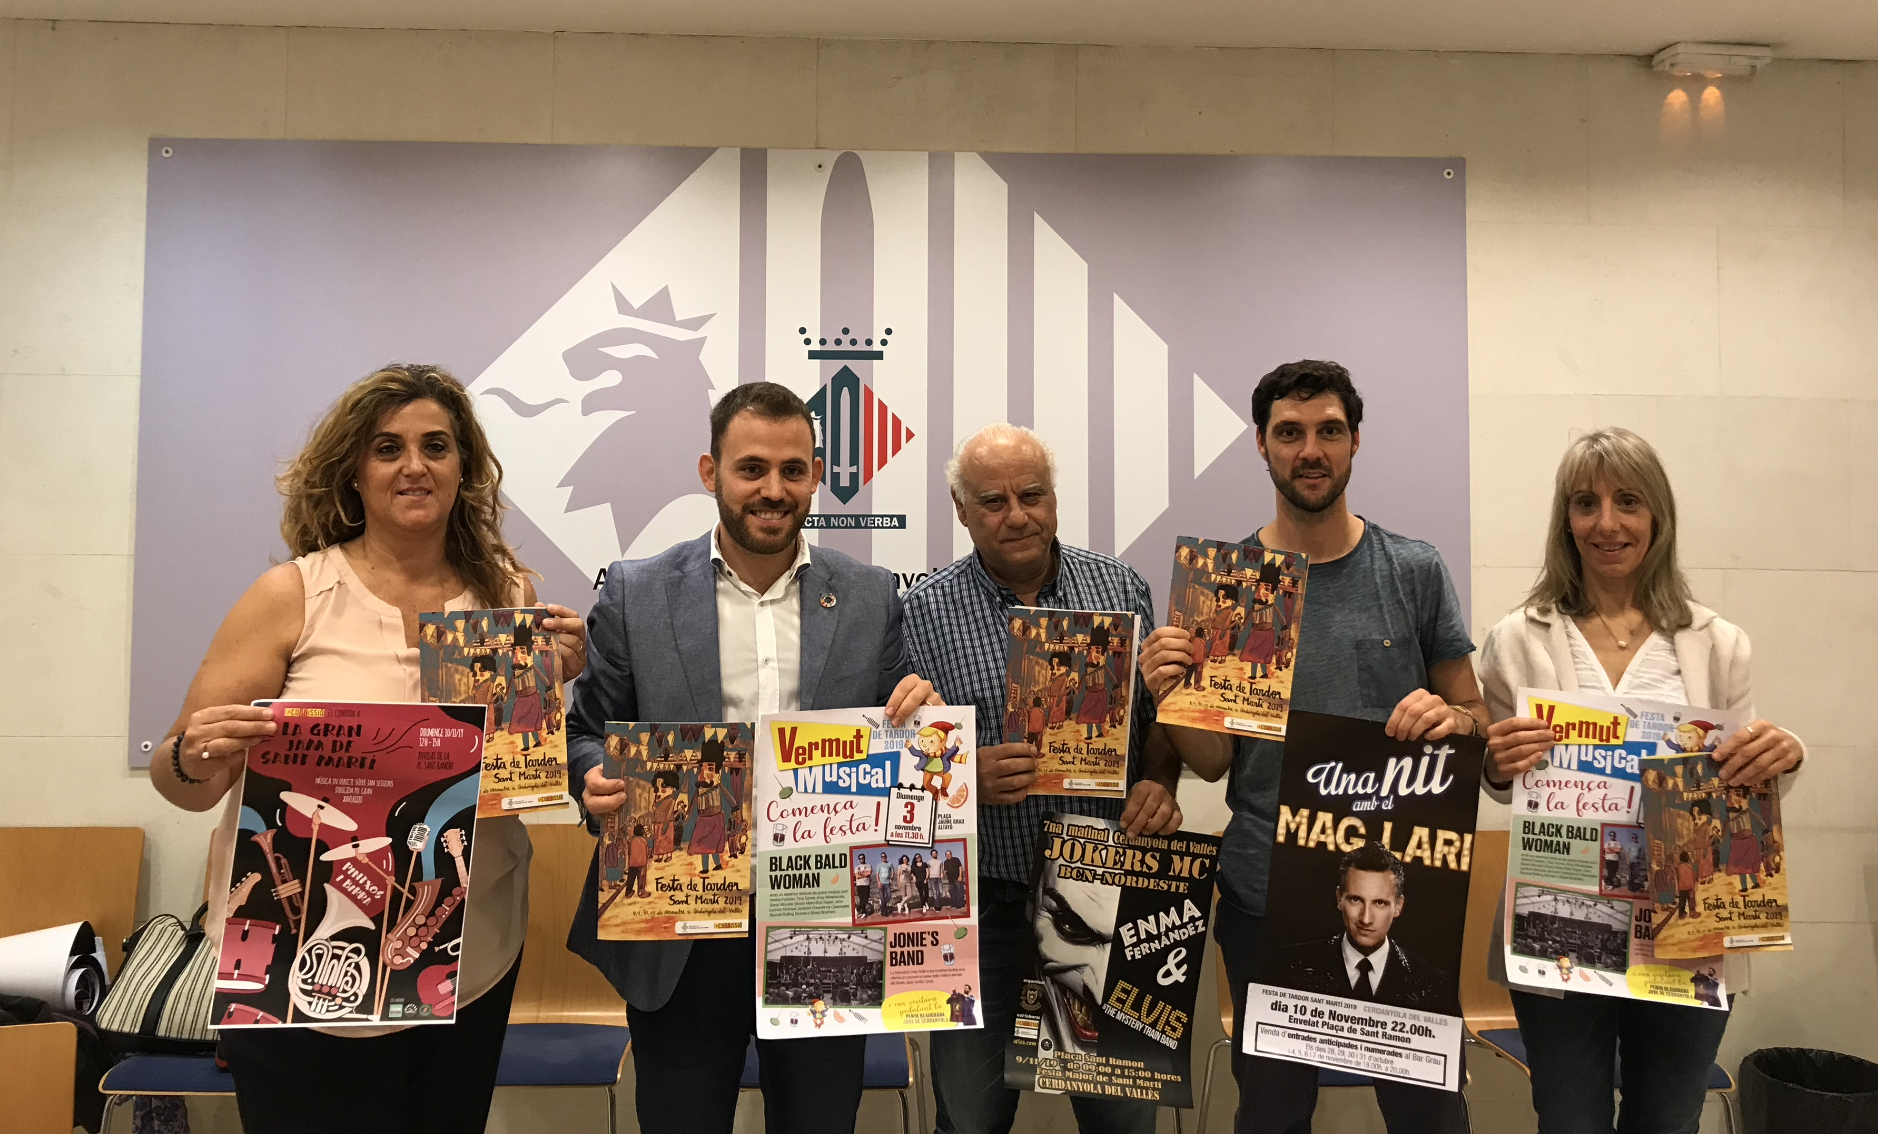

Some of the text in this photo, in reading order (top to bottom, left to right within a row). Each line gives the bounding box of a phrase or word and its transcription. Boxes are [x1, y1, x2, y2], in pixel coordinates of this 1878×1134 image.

[830, 517, 855, 527] NON
[860, 517, 900, 527] VERBA
[1208, 675, 1282, 700] Festa de Tardor
[1219, 692, 1240, 705] Sant
[1242, 696, 1264, 709] Martí
[1267, 702, 1284, 712] 2019
[1536, 704, 1621, 744] Vermut
[1630, 719, 1674, 732] DE TARDOR
[1640, 711, 1665, 722] FESTA
[282, 722, 362, 738] LA GRAN
[872, 729, 916, 740] DE TARDOR
[1641, 730, 1662, 741] 2019
[286, 738, 354, 754] JAM DE
[778, 726, 864, 766] Vermut
[884, 740, 904, 750] 2019
[1048, 740, 1119, 756] Festa de Tardor
[260, 750, 377, 770] SANT MARTÍ
[510, 756, 522, 768] de
[522, 752, 560, 769] Tardor
[1058, 756, 1120, 768] Sant Martí 2019
[493, 768, 562, 784] Sant Martí 2019
[798, 760, 891, 793] Musical
[1306, 744, 1455, 797] Una nit
[1522, 770, 1611, 792] Comença
[896, 792, 924, 802] Diumenge
[1352, 795, 1394, 812] amb el
[1546, 793, 1568, 812] la
[766, 800, 858, 823] Comença
[902, 802, 916, 824] 3
[792, 823, 817, 843] la
[894, 824, 922, 832] novembre
[1044, 820, 1064, 834] 7na
[1068, 824, 1109, 842] matinal
[1170, 840, 1187, 852] del
[1190, 842, 1218, 856] Vallès
[1276, 804, 1367, 853] MAG
[1381, 821, 1474, 872] LARI
[1522, 820, 1599, 842] BLACK BALD
[1521, 836, 1571, 856] WOMAN
[770, 852, 848, 872] BLACK BALD
[1044, 838, 1210, 880] JOKERS MC
[342, 862, 384, 898] PINTXOS
[655, 874, 742, 892] Festa de Tardor
[770, 872, 820, 890] WOMAN
[1058, 866, 1189, 894] BCN-NORDESTE
[342, 878, 372, 906] BIRRA
[668, 892, 742, 906] Sant Martí 2019
[1702, 894, 1782, 912] Festa de Tardor
[1118, 898, 1202, 946] ENMA
[1715, 910, 1734, 922] Sant
[1766, 912, 1782, 920] 2019
[890, 930, 939, 948] JONIE'S
[1124, 919, 1206, 960] FERNÁNDEZ
[890, 950, 924, 966] BAND
[1156, 947, 1188, 986] &
[1262, 988, 1278, 997] FESTA
[1288, 993, 1309, 1002] TARDOR
[1310, 996, 1324, 1004] SANT
[1326, 999, 1344, 1007] MARTÍ
[1108, 980, 1188, 1040] ELVIS
[1270, 1000, 1436, 1039] dia 10 de Novembre 22.00h.
[1363, 1005, 1407, 1019] CERDANYOLA
[1408, 1014, 1420, 1022] DEL
[1116, 1010, 1144, 1032] MYSTERY
[1143, 1024, 1162, 1042] TRAIN
[1160, 1034, 1178, 1050] BAND
[1288, 1015, 1412, 1044] Envelat Plaça de Sant Ramon
[1260, 1026, 1280, 1036] Venda
[1318, 1037, 1358, 1051] anticipades
[1360, 1044, 1363, 1052] i
[1364, 1046, 1402, 1058] numerades
[1412, 1053, 1424, 1062] Bar
[1426, 1056, 1441, 1066] Grau
[1016, 1056, 1058, 1068] 9/11/19
[1068, 1060, 1080, 1070] de
[1082, 1063, 1112, 1073] 09:00
[1124, 1068, 1152, 1078] 15:00
[1154, 1072, 1182, 1082] hores
[1054, 1050, 1144, 1068] Plaça Sant Ramon
[1036, 1068, 1162, 1088] Festa Major de Sant Martí
[1038, 1078, 1160, 1100] CERDANYOLA DEL VALLÈS
